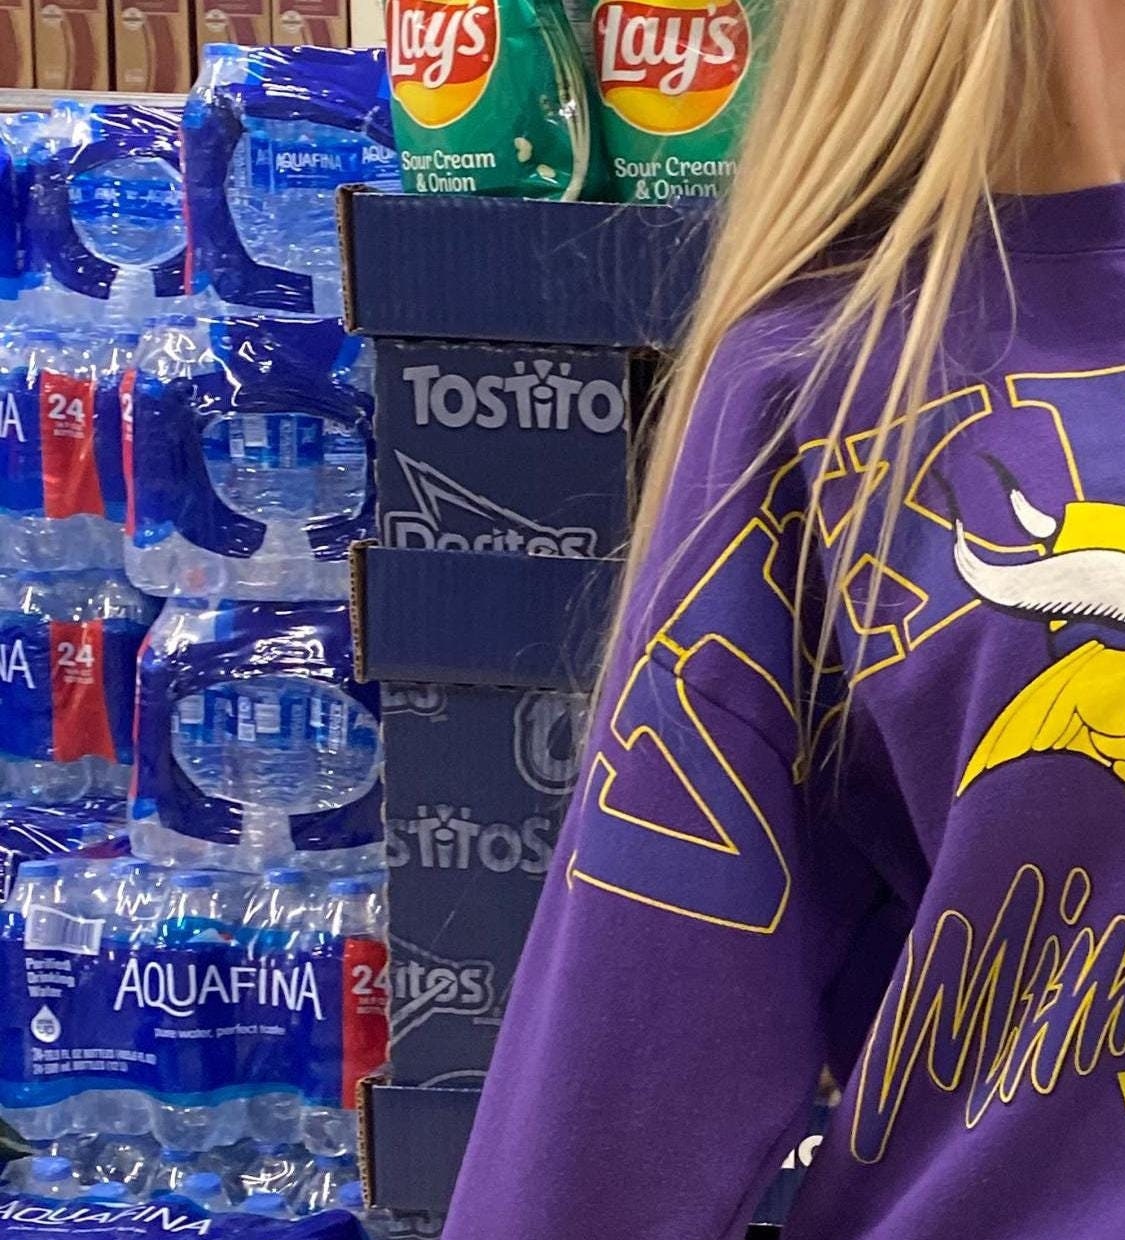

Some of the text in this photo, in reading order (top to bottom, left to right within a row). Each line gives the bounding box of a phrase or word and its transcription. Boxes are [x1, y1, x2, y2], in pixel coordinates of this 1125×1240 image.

[602, 4, 738, 95] Lay's
[401, 150, 496, 171] Sour Cream
[615, 156, 738, 177] Sour Cream
[635, 179, 718, 200] & Onion
[0, 393, 25, 442] A
[48, 393, 86, 423] 24
[57, 642, 95, 668] 24
[113, 957, 326, 1021] AQUAFINA
[0, 1201, 212, 1236] AQUAFINA
